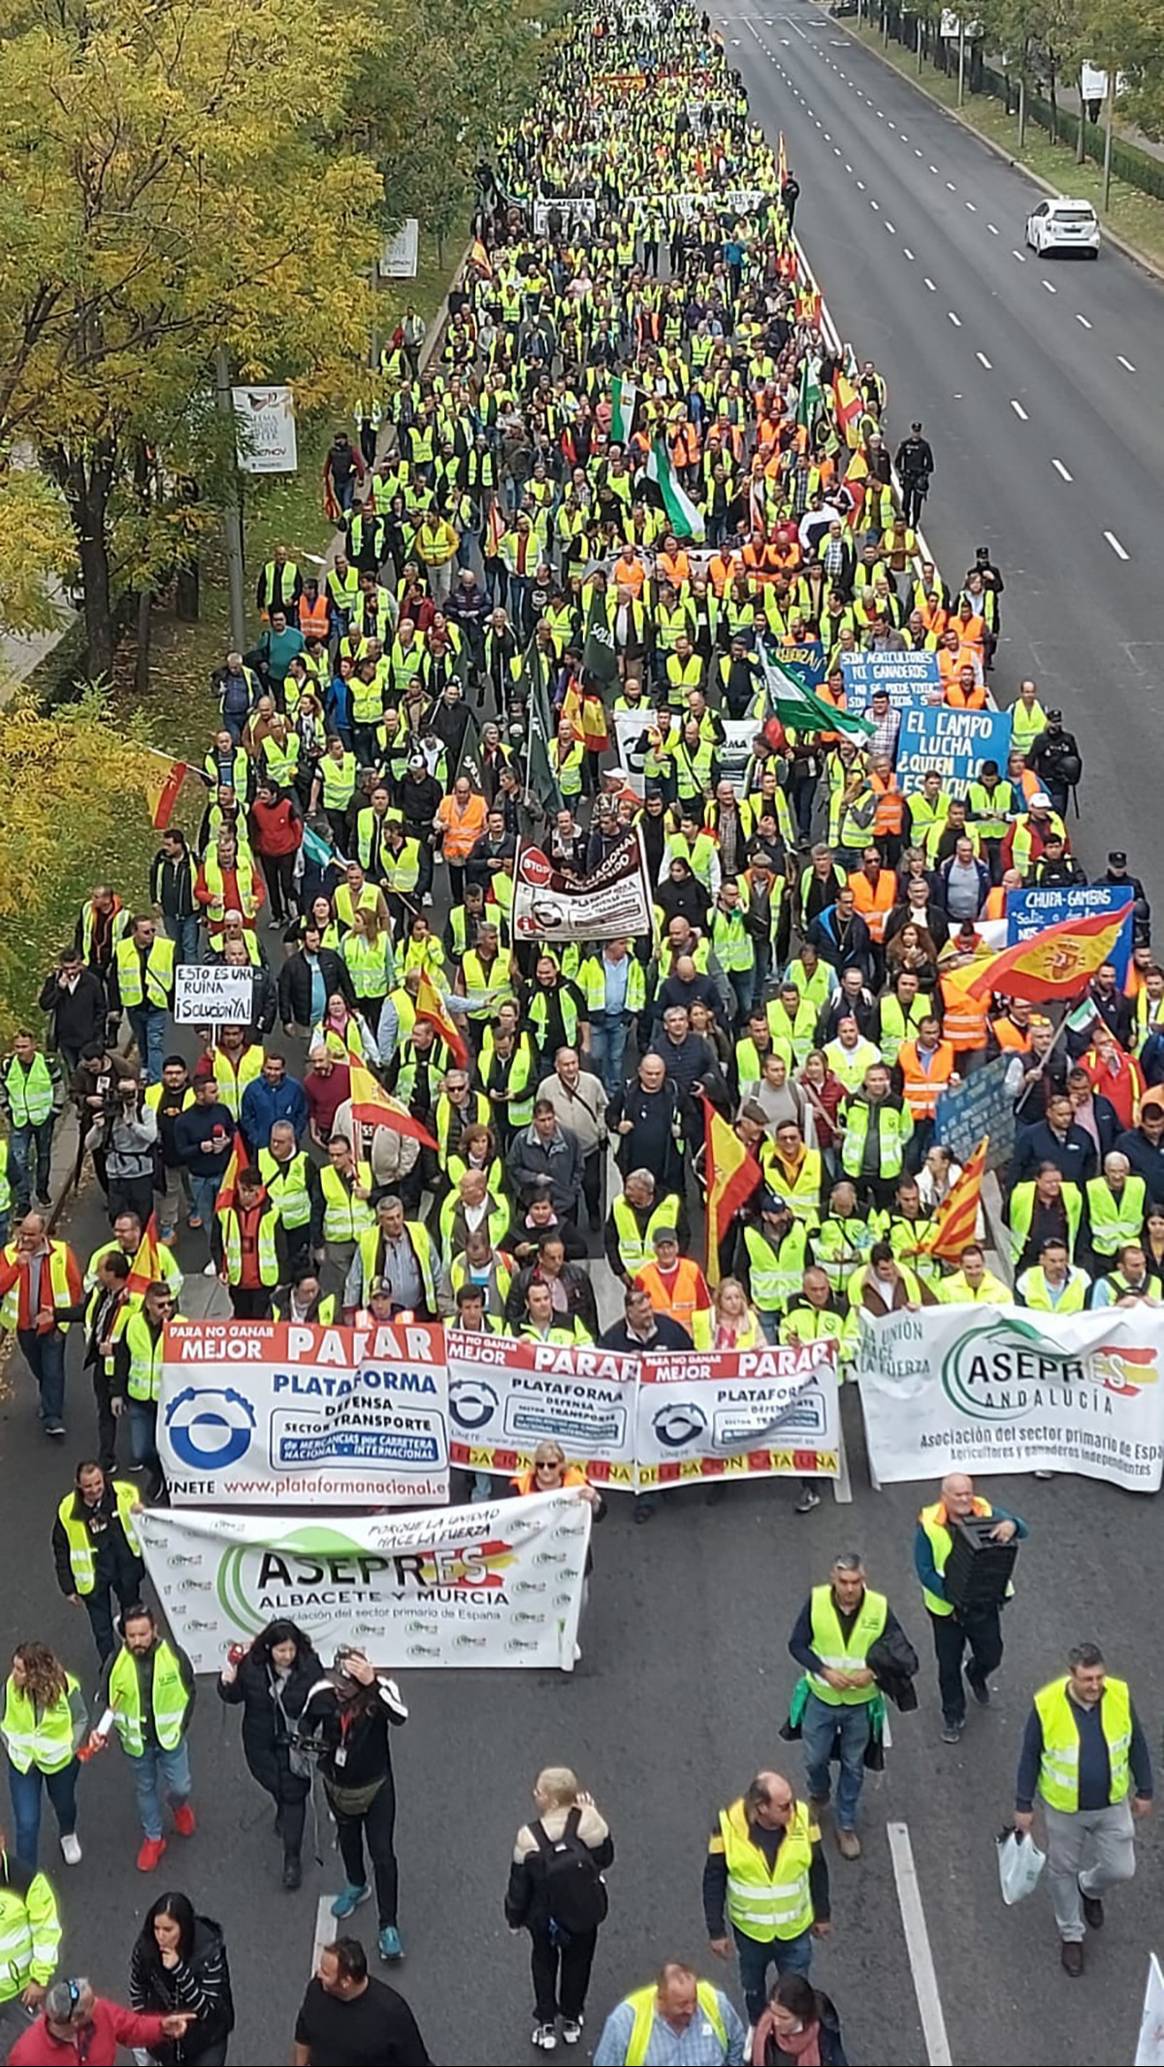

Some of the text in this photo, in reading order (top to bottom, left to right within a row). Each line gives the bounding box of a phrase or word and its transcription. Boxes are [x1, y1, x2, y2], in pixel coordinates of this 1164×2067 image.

[842, 652, 933, 665] SIN AGRICULTORES
[852, 665, 928, 680] NI GANADEROS
[885, 682, 910, 694] PUEDE
[848, 696, 866, 708] SIN
[907, 710, 993, 739] EL CAMPO
[919, 736, 973, 757] LUCHA
[896, 751, 954, 776] ¿QUIEN
[523, 858, 551, 874] STOP
[1025, 889, 1112, 908] CHUPA-GAMBAS
[178, 968, 253, 980] ESTO ES UNA
[231, 998, 251, 1020] YA!
[170, 1326, 274, 1338] PARA NO GANAR
[181, 1340, 262, 1360] MEJOR
[466, 1335, 481, 1346] NO
[483, 1338, 518, 1351] GANAR
[449, 1344, 506, 1366] MEJOR
[534, 1347, 637, 1381] PARAR
[646, 1354, 721, 1366] PARA NO GANAR
[738, 1343, 830, 1377] PARAR
[656, 1366, 711, 1382] MEJOR
[880, 1359, 930, 1377] FUERZA
[968, 1351, 1127, 1389] ASEPRES
[273, 1370, 437, 1397] PLATAFORMA
[512, 1378, 623, 1402] PLATAFORMA
[718, 1376, 819, 1403] PLATAFORA
[325, 1396, 393, 1416] DEFENSA
[546, 1397, 594, 1411] DEFENSA
[986, 1384, 1114, 1416] ANDALUCÍA
[333, 1413, 431, 1431] TRANSPORTE
[550, 1407, 615, 1421] TRANSPORTE
[285, 1422, 329, 1434] SECTOR
[284, 1441, 297, 1451] de
[362, 1434, 377, 1445] por
[379, 1436, 433, 1449] CARRETERA
[920, 1426, 992, 1448] Asociación
[995, 1426, 1015, 1442] del
[1019, 1426, 1061, 1441] sector
[1066, 1427, 1117, 1453] primario
[284, 1445, 434, 1459] NACIONAL INTERNACIONAL
[426, 1518, 443, 1529] LA
[377, 1534, 413, 1548] HACE
[417, 1532, 435, 1545] LA
[440, 1523, 491, 1541] FUERZA
[258, 1547, 488, 1589] ASEPRES
[259, 1591, 380, 1609] ALBACETE
[391, 1591, 406, 1602] Y
[417, 1589, 510, 1605] MURCIA
[335, 1608, 351, 1619] del
[355, 1608, 390, 1619] sector
[393, 1608, 438, 1619] primario
[441, 1609, 455, 1619] de
[458, 1609, 501, 1620] España
